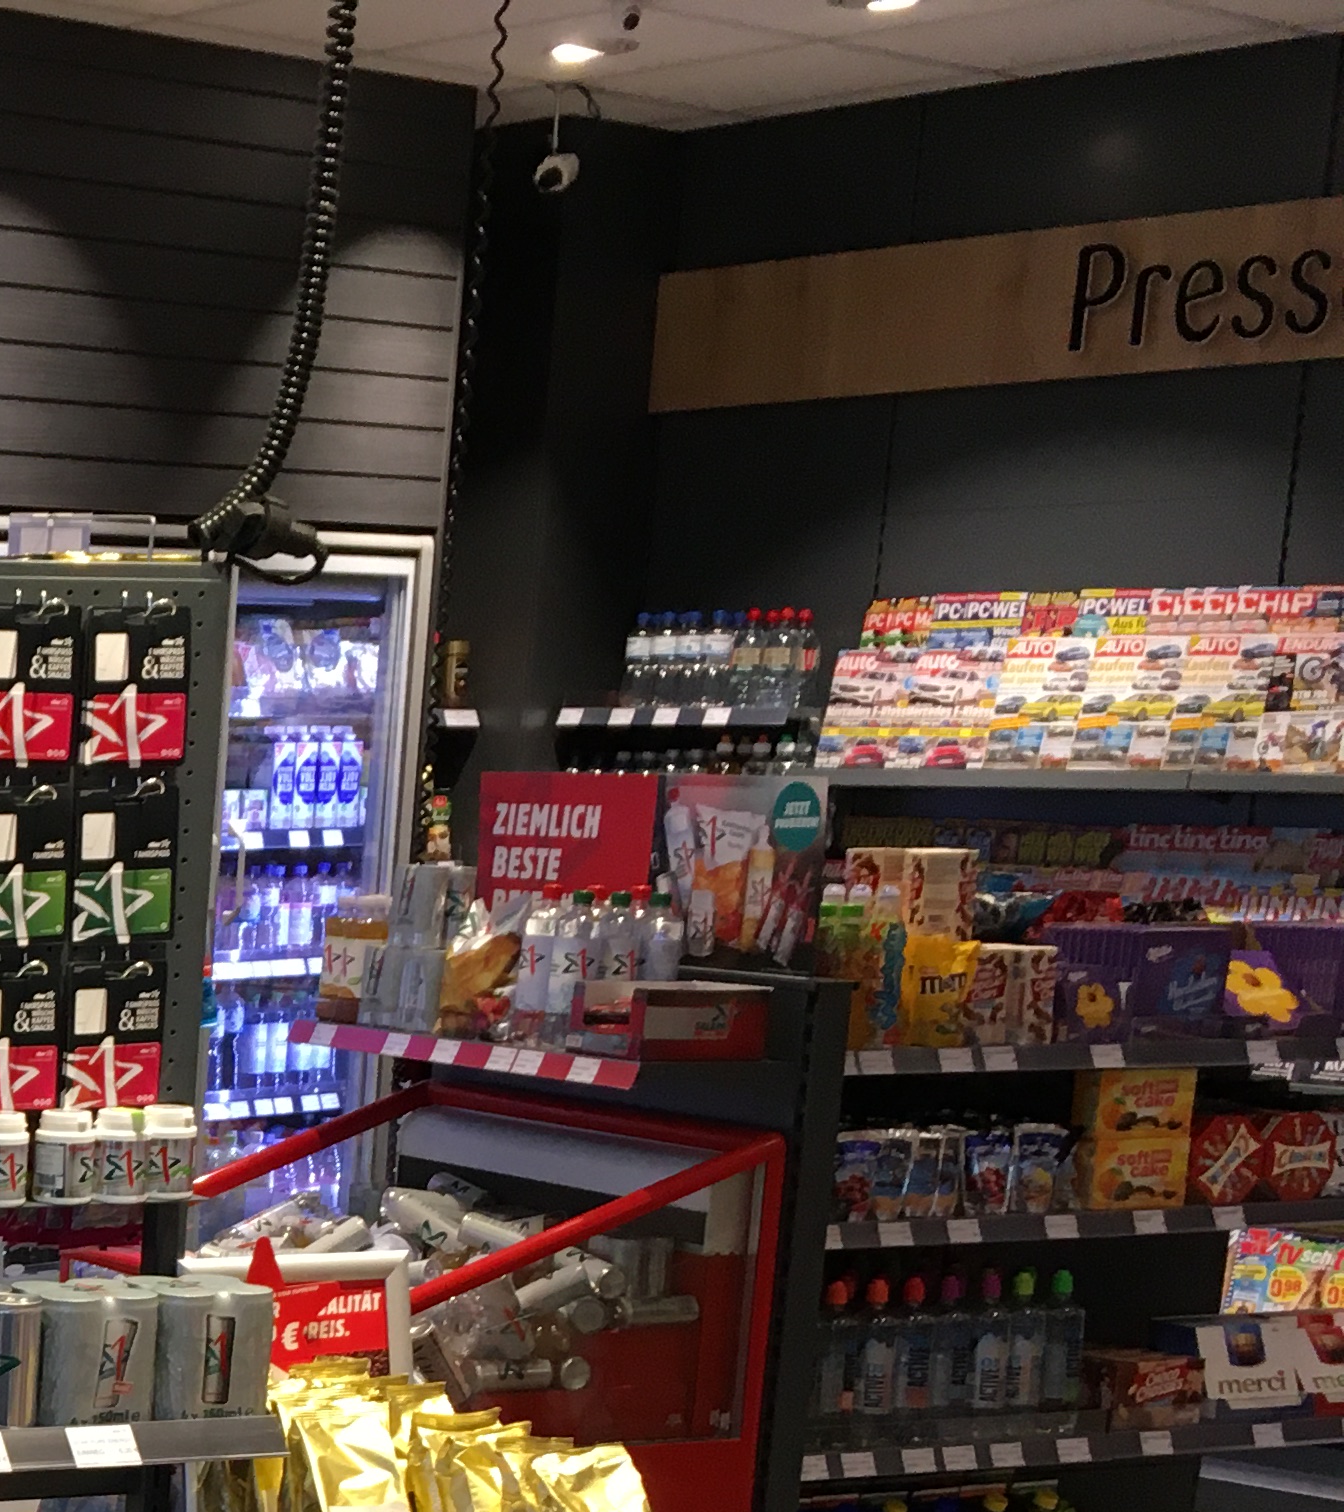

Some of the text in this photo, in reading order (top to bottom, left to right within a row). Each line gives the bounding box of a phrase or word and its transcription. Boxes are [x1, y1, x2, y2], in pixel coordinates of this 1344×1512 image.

[1068, 242, 1344, 352] Press
[1239, 593, 1315, 615] CHIP
[1009, 640, 1053, 655] AUTO
[1103, 638, 1144, 653] AUTO
[1196, 638, 1239, 652] AUTO
[493, 803, 602, 838] ZIEMLICH
[492, 846, 562, 880] BESTE
[1117, 1148, 1149, 1166] soft
[1129, 1160, 1171, 1179] cake
[303, 1319, 350, 1340] REIS.
[1217, 1370, 1287, 1395] merci
